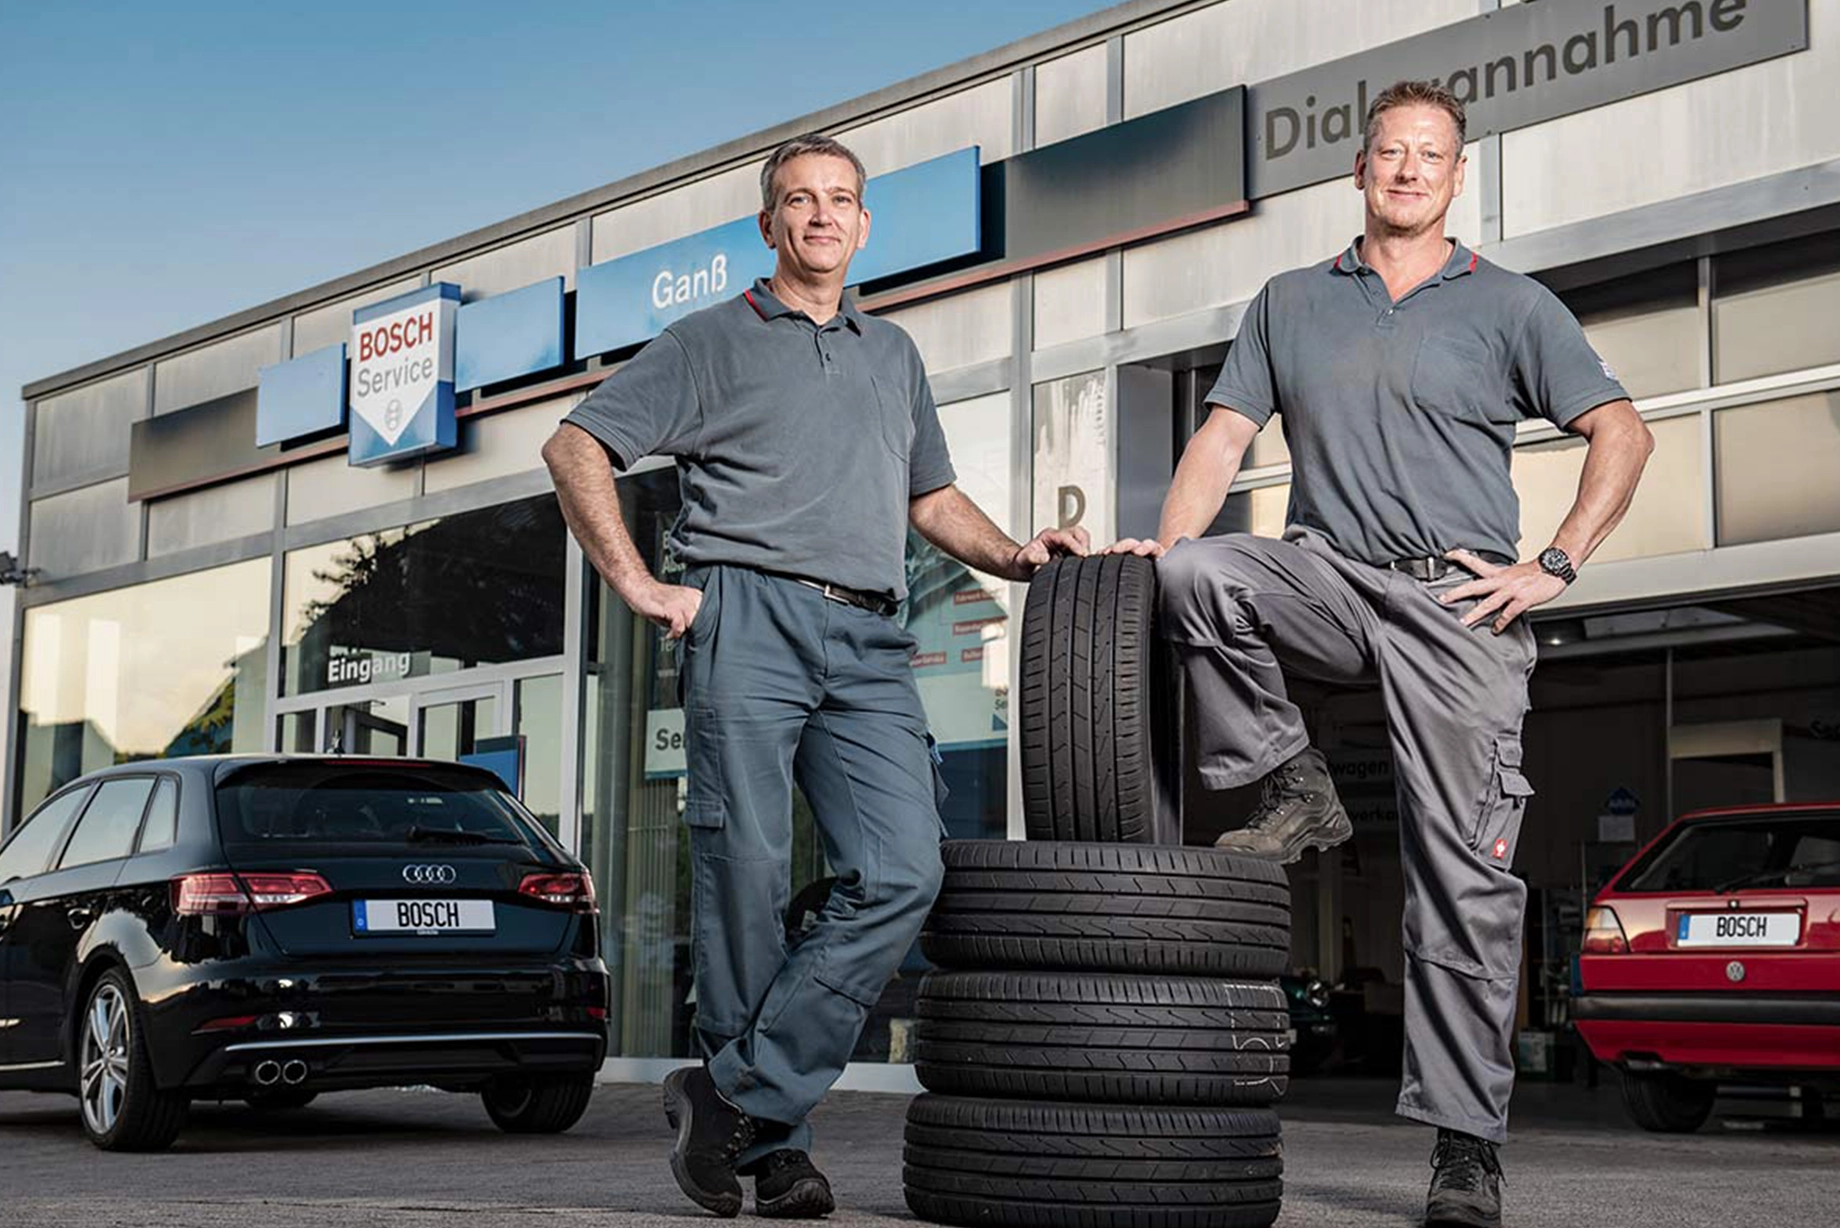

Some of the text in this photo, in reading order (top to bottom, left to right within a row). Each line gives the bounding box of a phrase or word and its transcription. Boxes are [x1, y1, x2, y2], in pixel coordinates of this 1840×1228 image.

[1265, 0, 1747, 160] Dialannahme
[652, 254, 727, 309] Ganß
[360, 311, 433, 362] BOSCH
[357, 357, 433, 398] Service
[328, 652, 411, 683] Eingang
[397, 902, 460, 927] BOSCH
[1716, 916, 1768, 937] BOSCH
